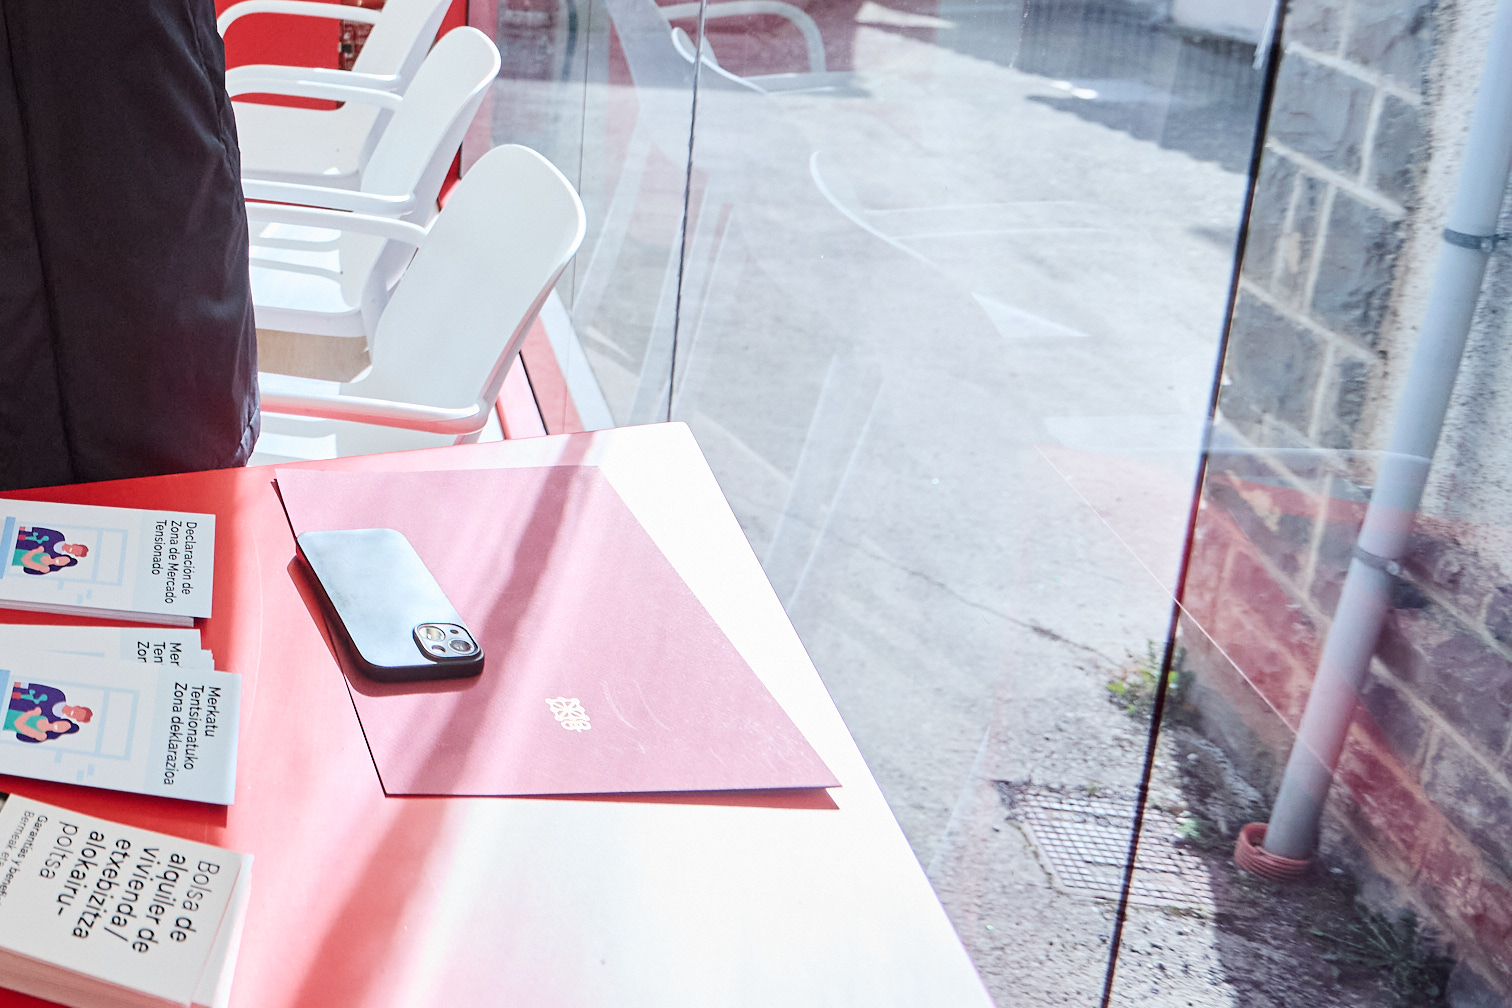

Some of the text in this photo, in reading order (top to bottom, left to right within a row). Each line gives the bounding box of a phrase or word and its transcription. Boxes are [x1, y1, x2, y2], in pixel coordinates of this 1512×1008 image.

[151, 519, 167, 575] Tensionado
[164, 520, 183, 604] Zona de Mercado
[181, 521, 198, 595] Declaración de
[153, 641, 166, 664] Ten
[169, 642, 182, 666] Mer
[163, 682, 188, 786] Zona deklarazioa
[183, 685, 205, 770] Tentsionatuko
[204, 686, 222, 738] Merkatu
[5, 811, 35, 851] Bermeak
[11, 859, 22, 867] y
[17, 815, 48, 859] Garantías
[39, 821, 80, 880] poltsa
[56, 830, 107, 916] alokairu-
[71, 838, 131, 939] etxebizitza
[132, 853, 189, 953] alquiler de
[169, 860, 220, 943] Bolsa de
